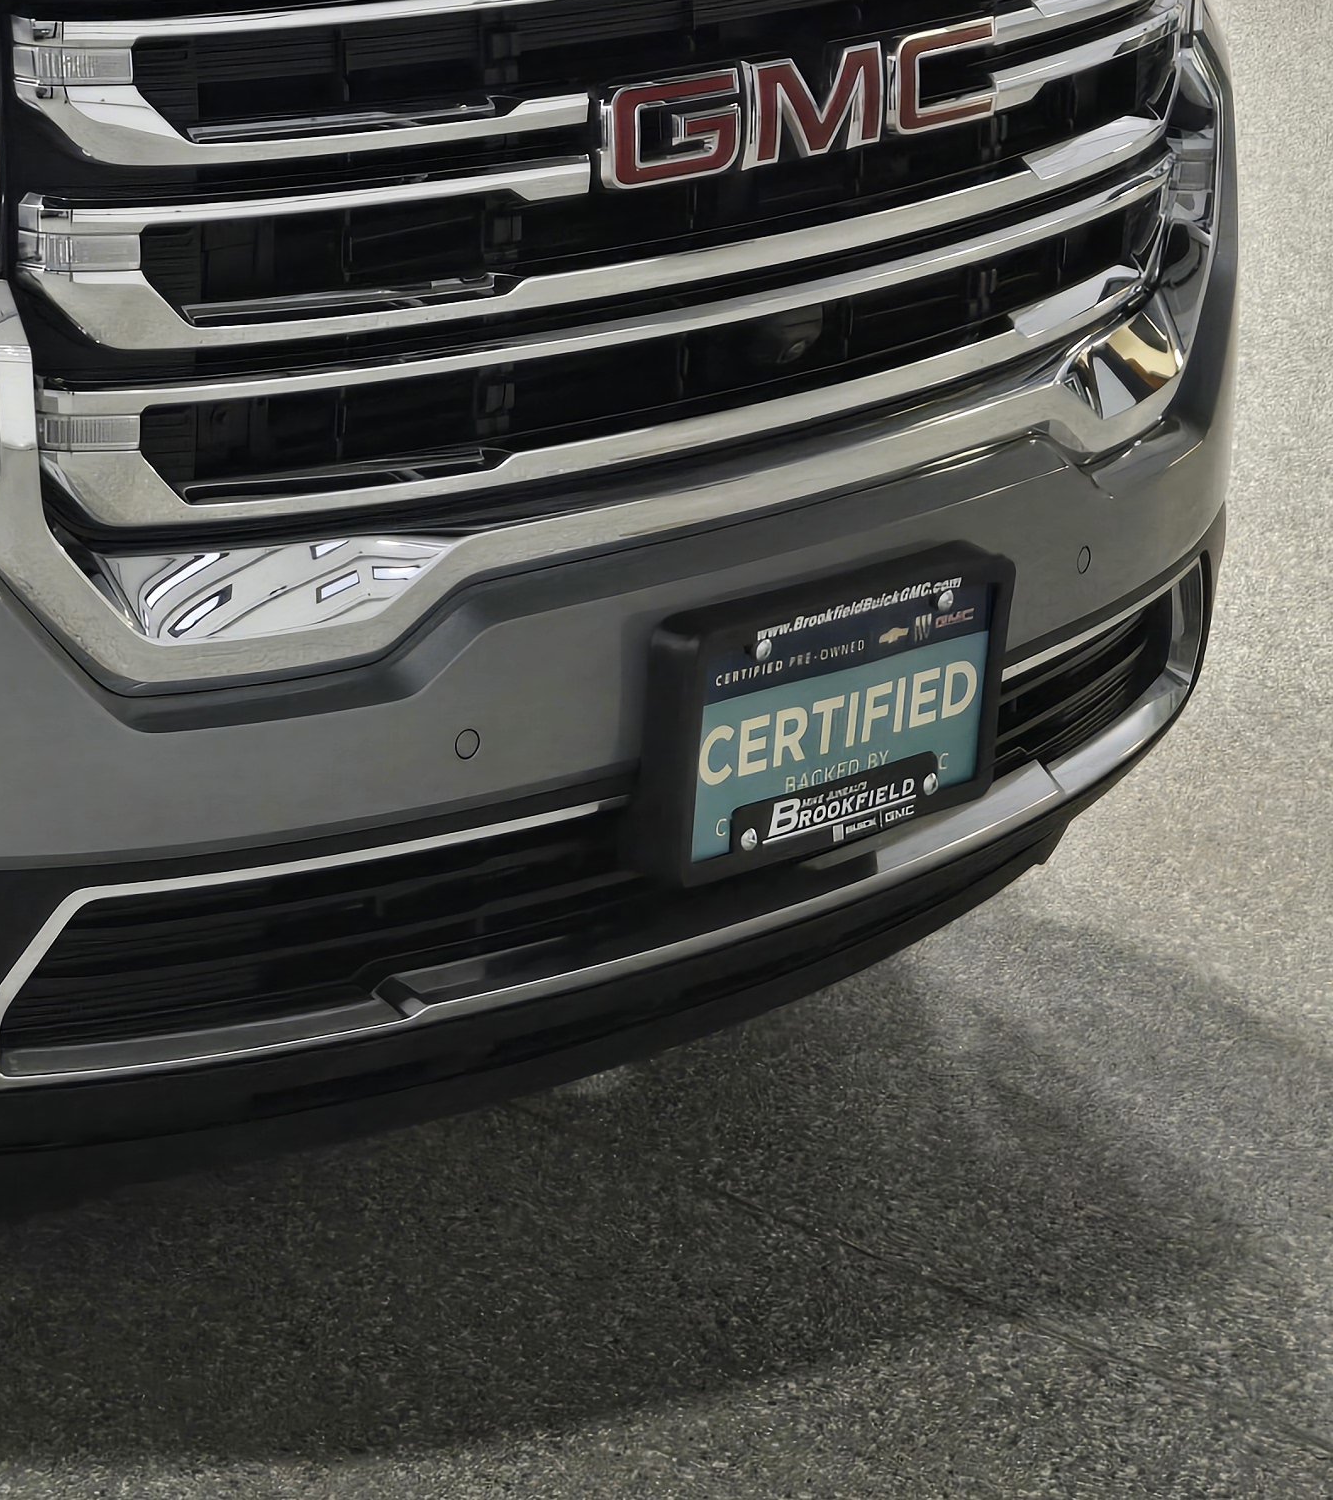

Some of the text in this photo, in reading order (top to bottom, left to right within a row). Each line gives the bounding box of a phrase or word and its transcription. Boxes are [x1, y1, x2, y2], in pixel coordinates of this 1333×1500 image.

[599, 15, 997, 190] GMC
[756, 576, 962, 642] www.BrookfieldBuickGMC.com
[715, 659, 783, 687] CERTIFIED
[698, 660, 978, 786] CERTIFIED
[785, 758, 860, 794] BACKED
[867, 750, 890, 770] BY
[767, 777, 916, 839] BROOKFIELD
